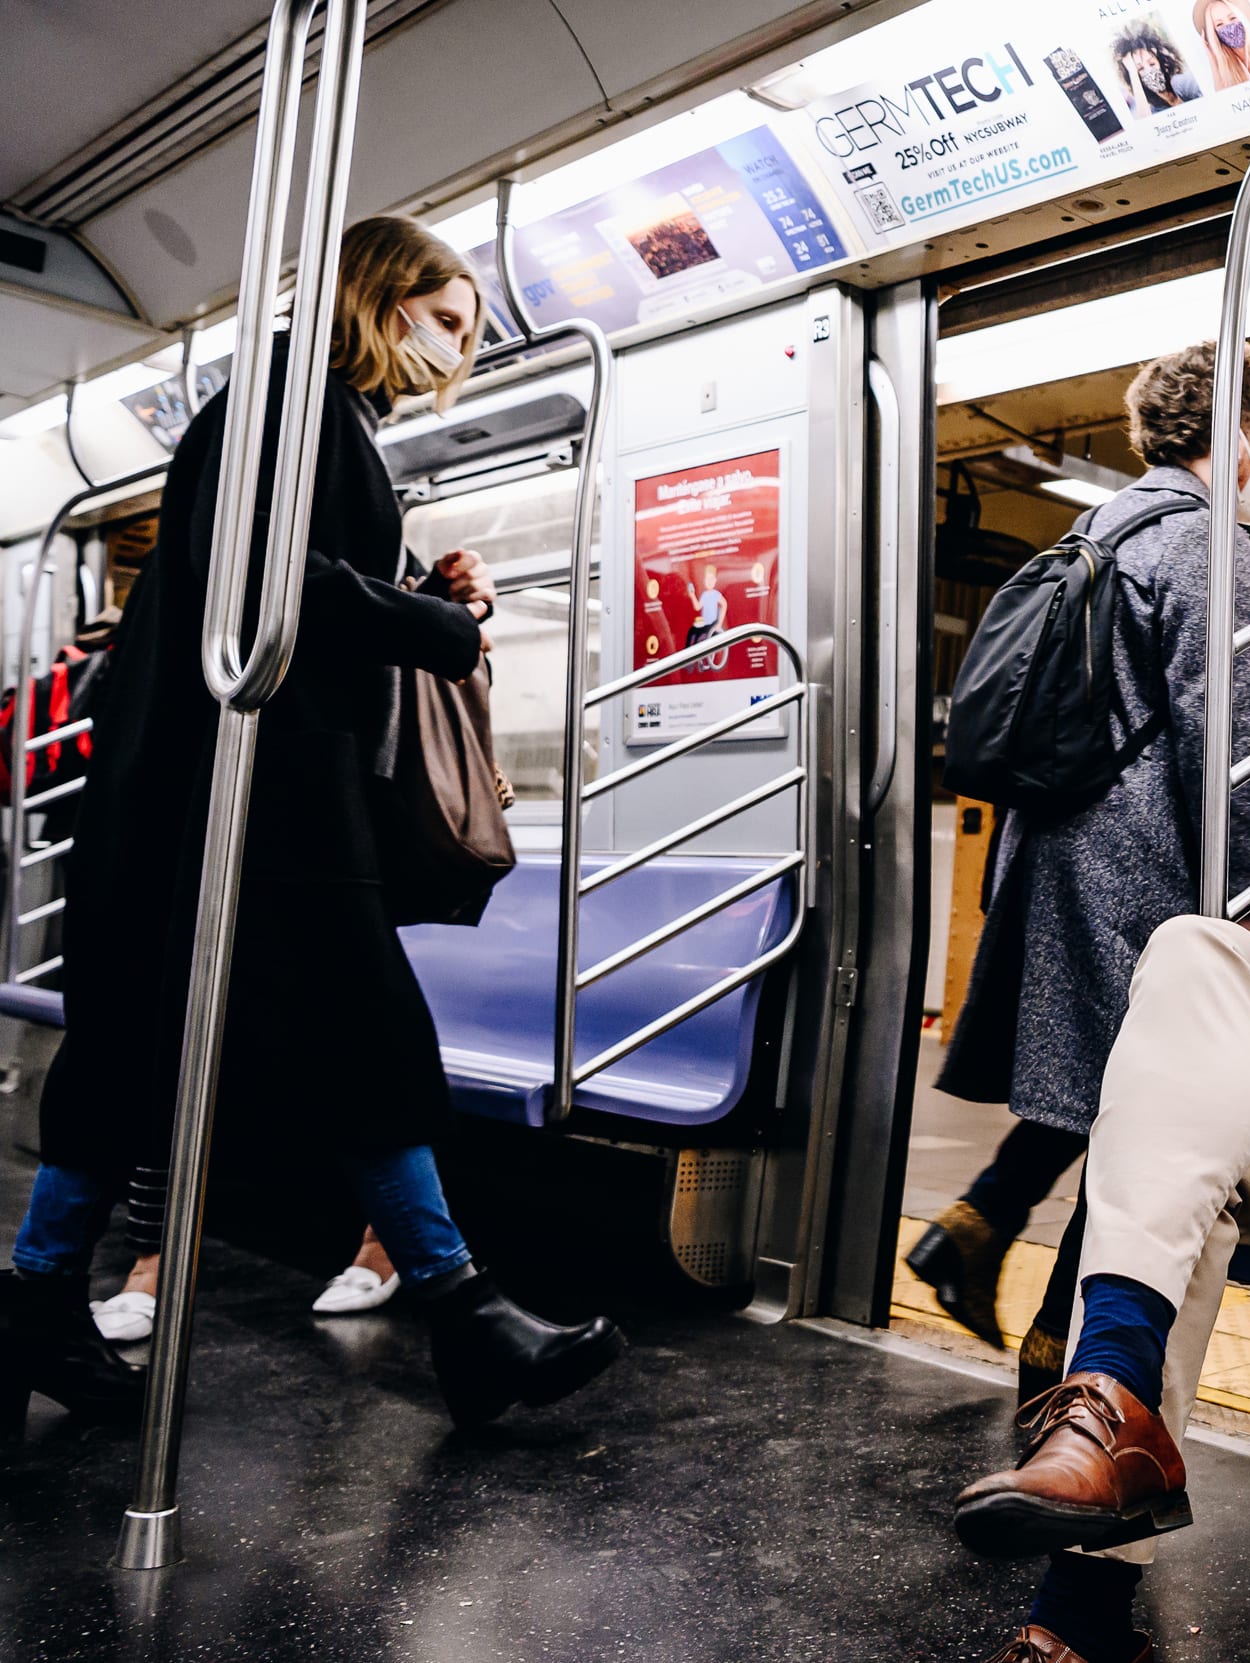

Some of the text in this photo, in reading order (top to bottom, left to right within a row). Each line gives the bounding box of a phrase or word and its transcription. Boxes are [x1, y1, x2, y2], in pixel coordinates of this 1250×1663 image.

[815, 42, 1035, 158] GERMTECH
[964, 113, 1029, 144] NYCSUBWAY
[927, 141, 1020, 180] VISIT US AT OUR WEBSITE
[900, 145, 1073, 216] GermTechUS.com
[814, 318, 830, 340] R3
